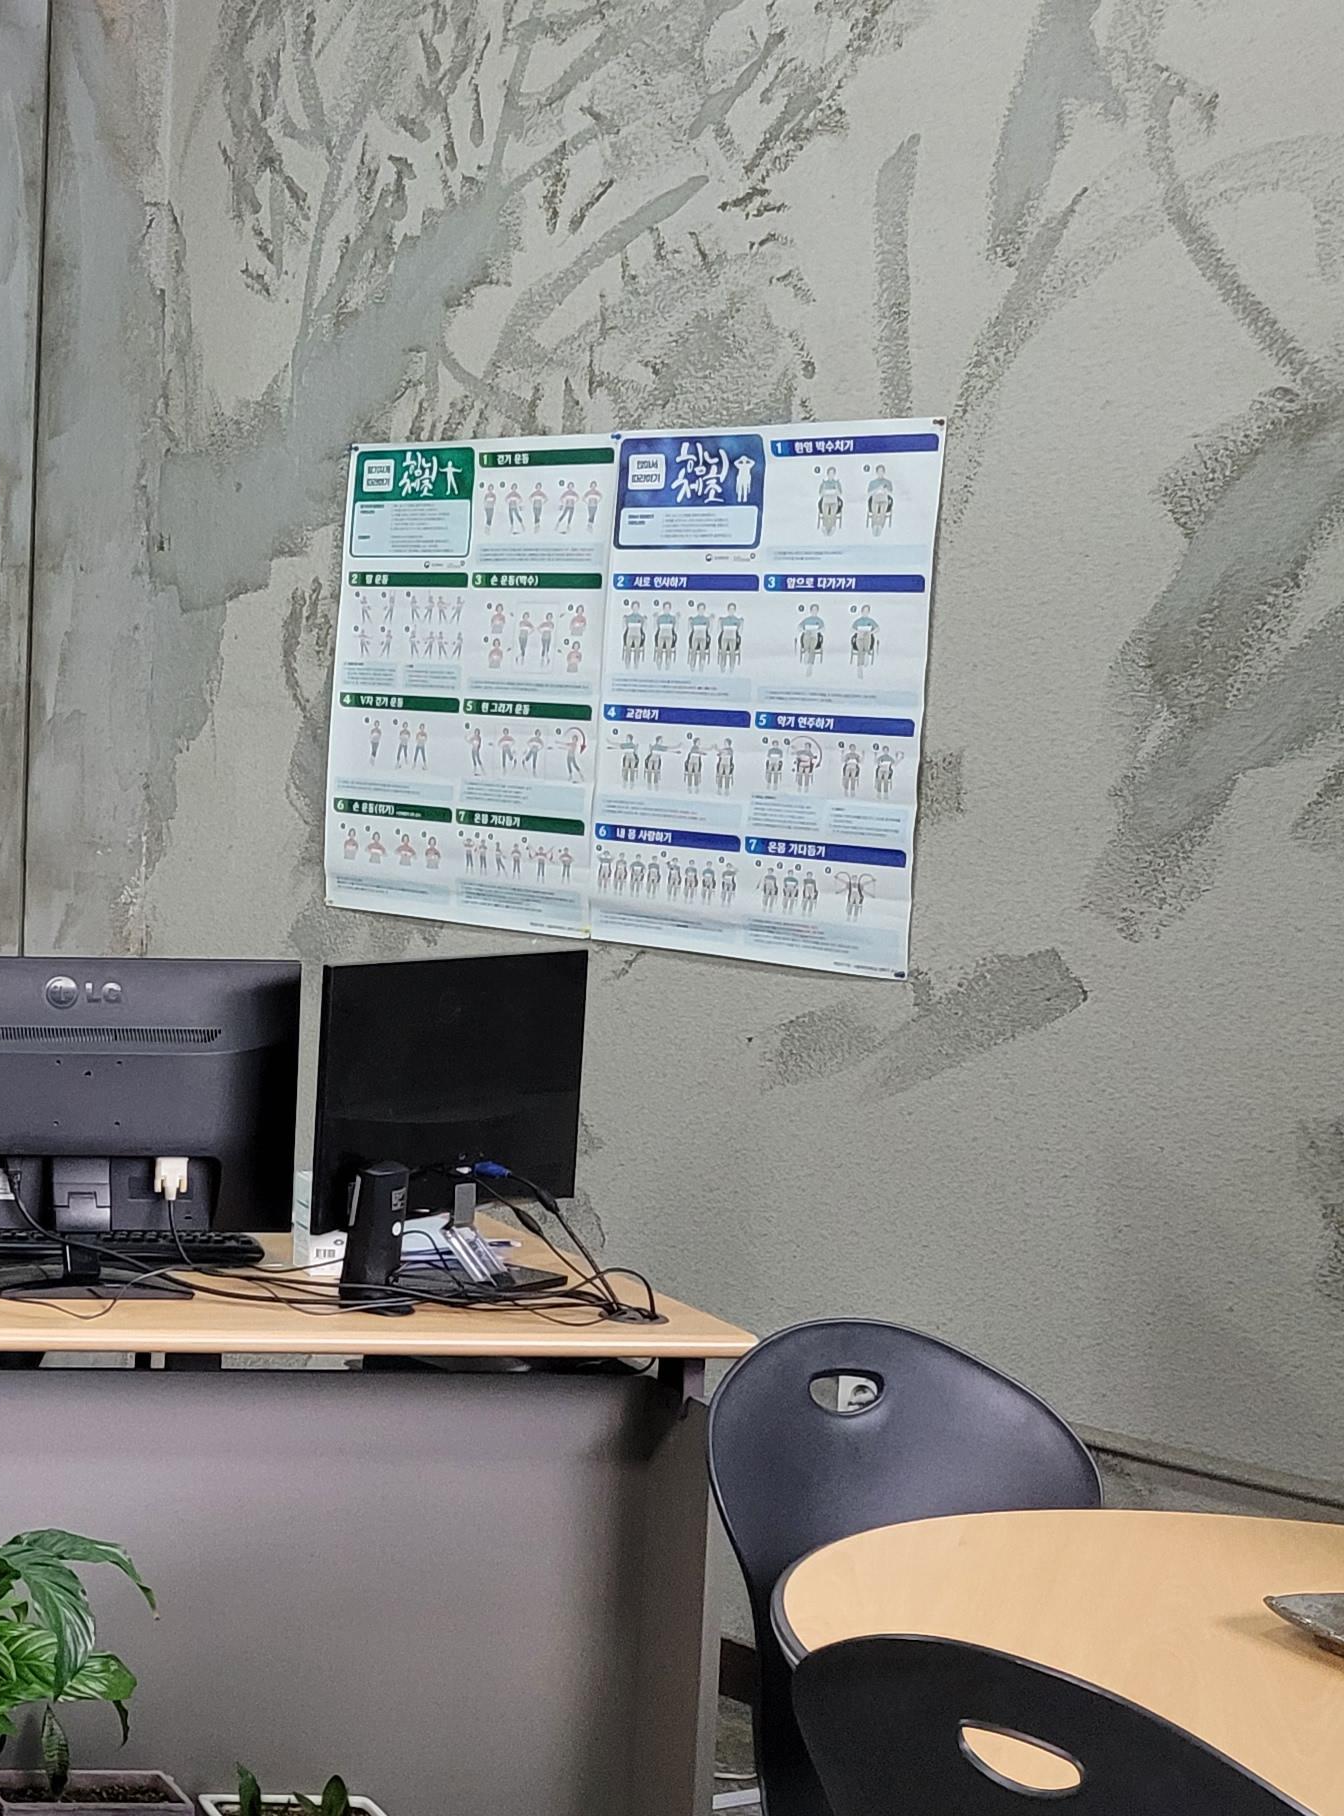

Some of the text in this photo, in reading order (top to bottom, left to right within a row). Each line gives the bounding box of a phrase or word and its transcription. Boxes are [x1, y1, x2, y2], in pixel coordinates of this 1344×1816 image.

[775, 441, 782, 453] 1
[815, 439, 854, 452] 박수치기
[483, 454, 489, 465] 1
[514, 452, 530, 466] 운동
[351, 574, 358, 585] 2
[374, 574, 389, 585] 운동
[475, 574, 482, 585] 3
[617, 576, 687, 588] 2 서로 인사하기
[768, 576, 856, 590] 3 앞으로 다가가기
[343, 694, 351, 705] 4
[390, 697, 404, 709] 운동
[466, 700, 473, 711] 5
[514, 703, 530, 715] 운동
[607, 706, 659, 720] 4 교감하기
[759, 714, 767, 725] 5
[798, 717, 834, 729] 연주하기
[337, 800, 344, 810] 6
[458, 811, 466, 822] 7
[599, 826, 607, 837] 6
[616, 828, 625, 840] 내
[638, 830, 672, 843] 사랑하기
[749, 839, 757, 850] 7
[85, 981, 122, 1004] LG
